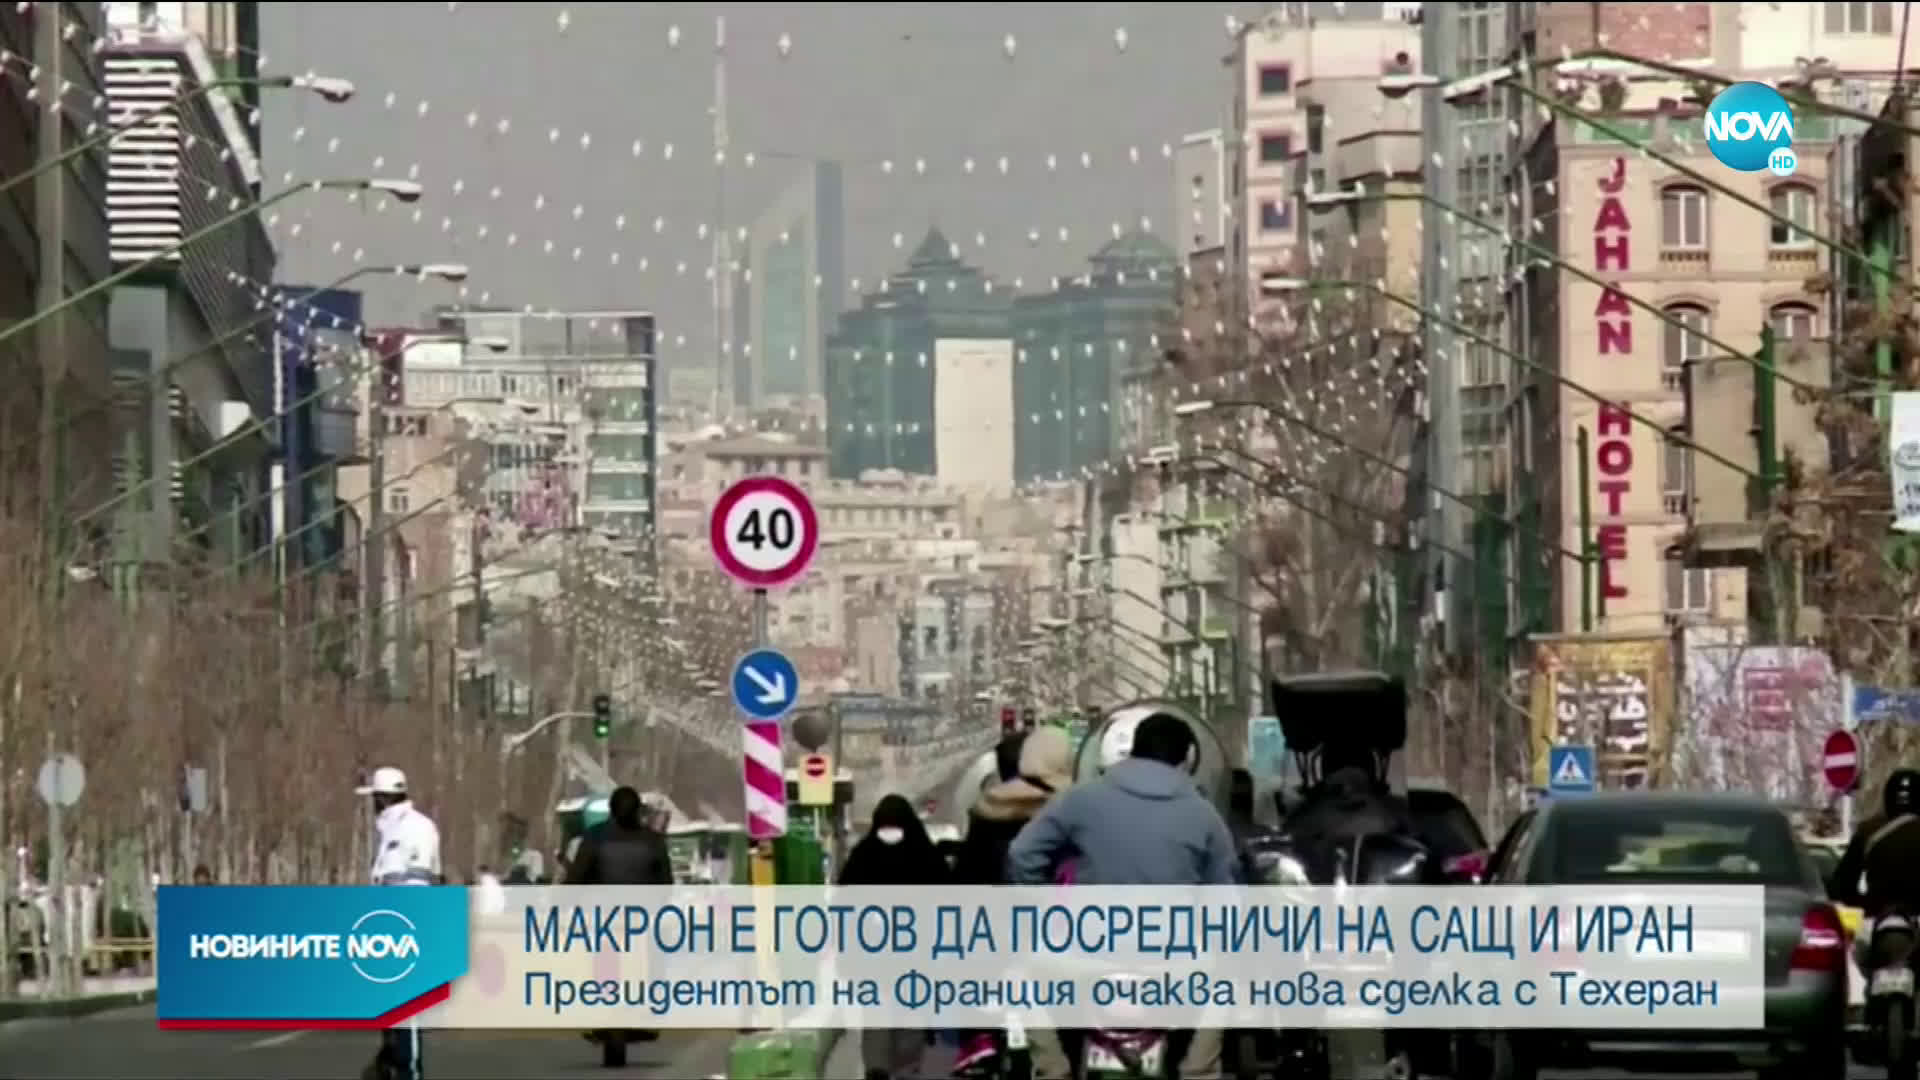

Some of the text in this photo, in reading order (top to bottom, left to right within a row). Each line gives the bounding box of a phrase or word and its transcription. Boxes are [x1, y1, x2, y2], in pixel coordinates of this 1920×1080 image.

[1594, 156, 1633, 599] JAHAN HOTEL
[736, 508, 794, 551] 40
